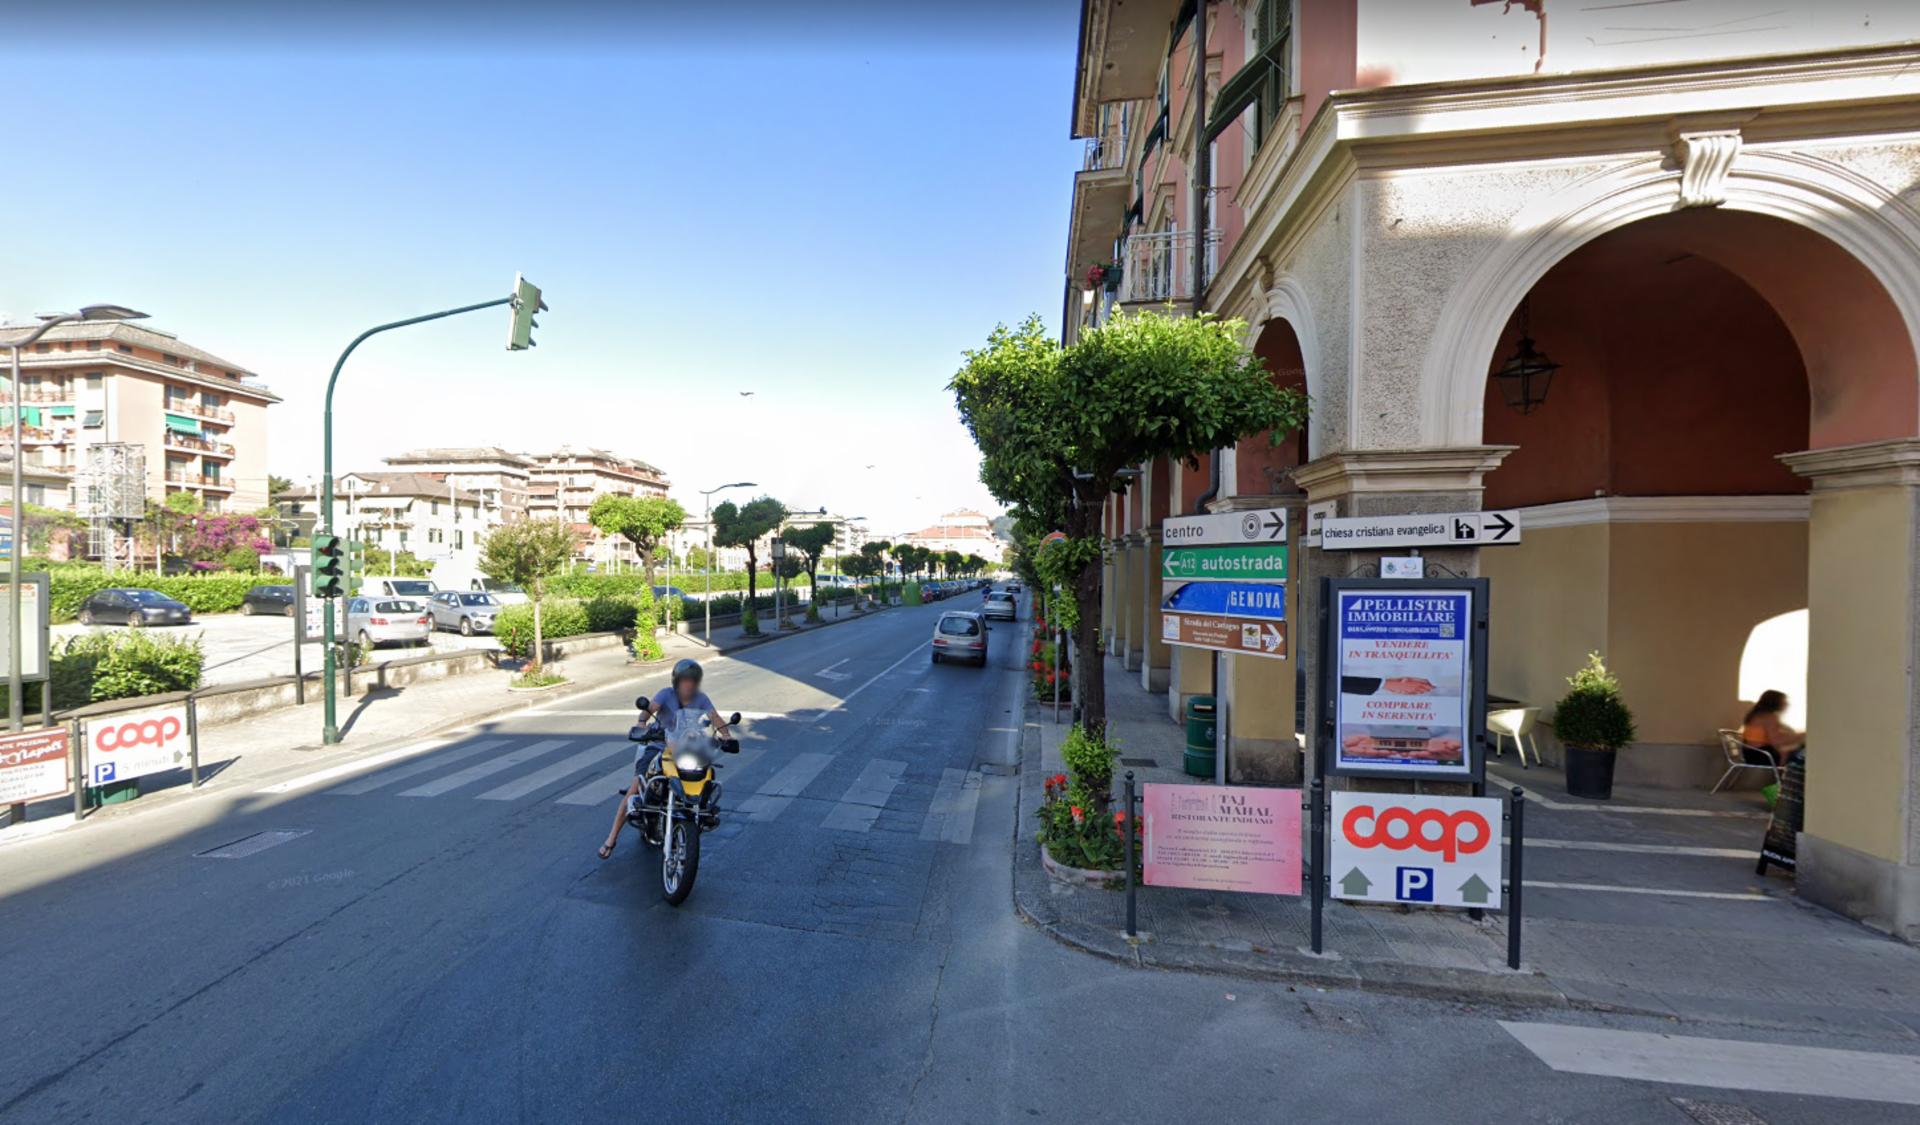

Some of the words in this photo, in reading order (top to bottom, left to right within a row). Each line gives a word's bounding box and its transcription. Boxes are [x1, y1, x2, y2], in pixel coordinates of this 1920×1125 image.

[1165, 525, 1204, 538] centro
[1325, 526, 1353, 538] chiesa
[1356, 525, 1394, 537] cristiana
[1397, 523, 1445, 537] evangelica
[1181, 558, 1195, 569] A12
[1202, 555, 1283, 570] autostrada
[1230, 591, 1281, 609] GENOVA
[1364, 599, 1455, 611] PELLISTRI
[1348, 612, 1455, 622] IMMOBILIARE
[1375, 641, 1429, 649] VENDERE
[1366, 701, 1432, 710] COMPRARE
[1361, 711, 1375, 719] IN
[1376, 712, 1437, 721] SERENITA'
[96, 716, 181, 752] coop
[98, 765, 113, 782] P
[1219, 795, 1246, 806] TAJ
[1219, 805, 1273, 817] MAHAL
[1171, 814, 1229, 823] RISTORANTE
[1232, 816, 1274, 825] INDIANO
[1341, 805, 1491, 863] coop
[1402, 869, 1428, 899] P
